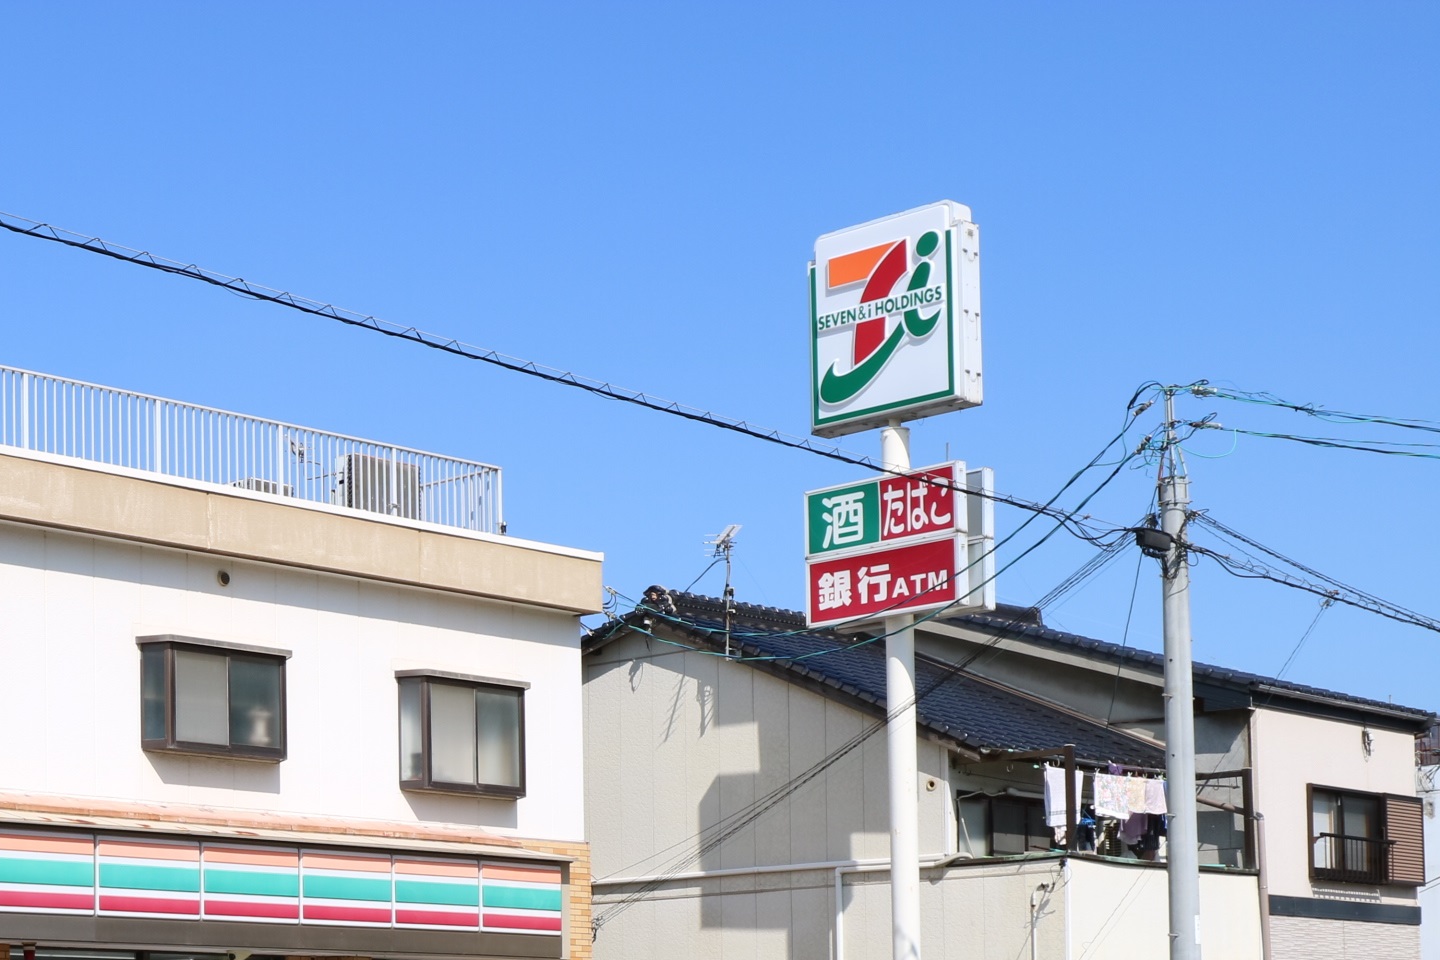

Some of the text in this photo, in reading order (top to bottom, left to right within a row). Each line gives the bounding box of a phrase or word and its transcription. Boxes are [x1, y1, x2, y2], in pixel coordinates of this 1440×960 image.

[875, 285, 943, 317] HOLDINGS
[821, 475, 951, 549] 酒 たばこ
[817, 563, 949, 612] 銀行ATM
